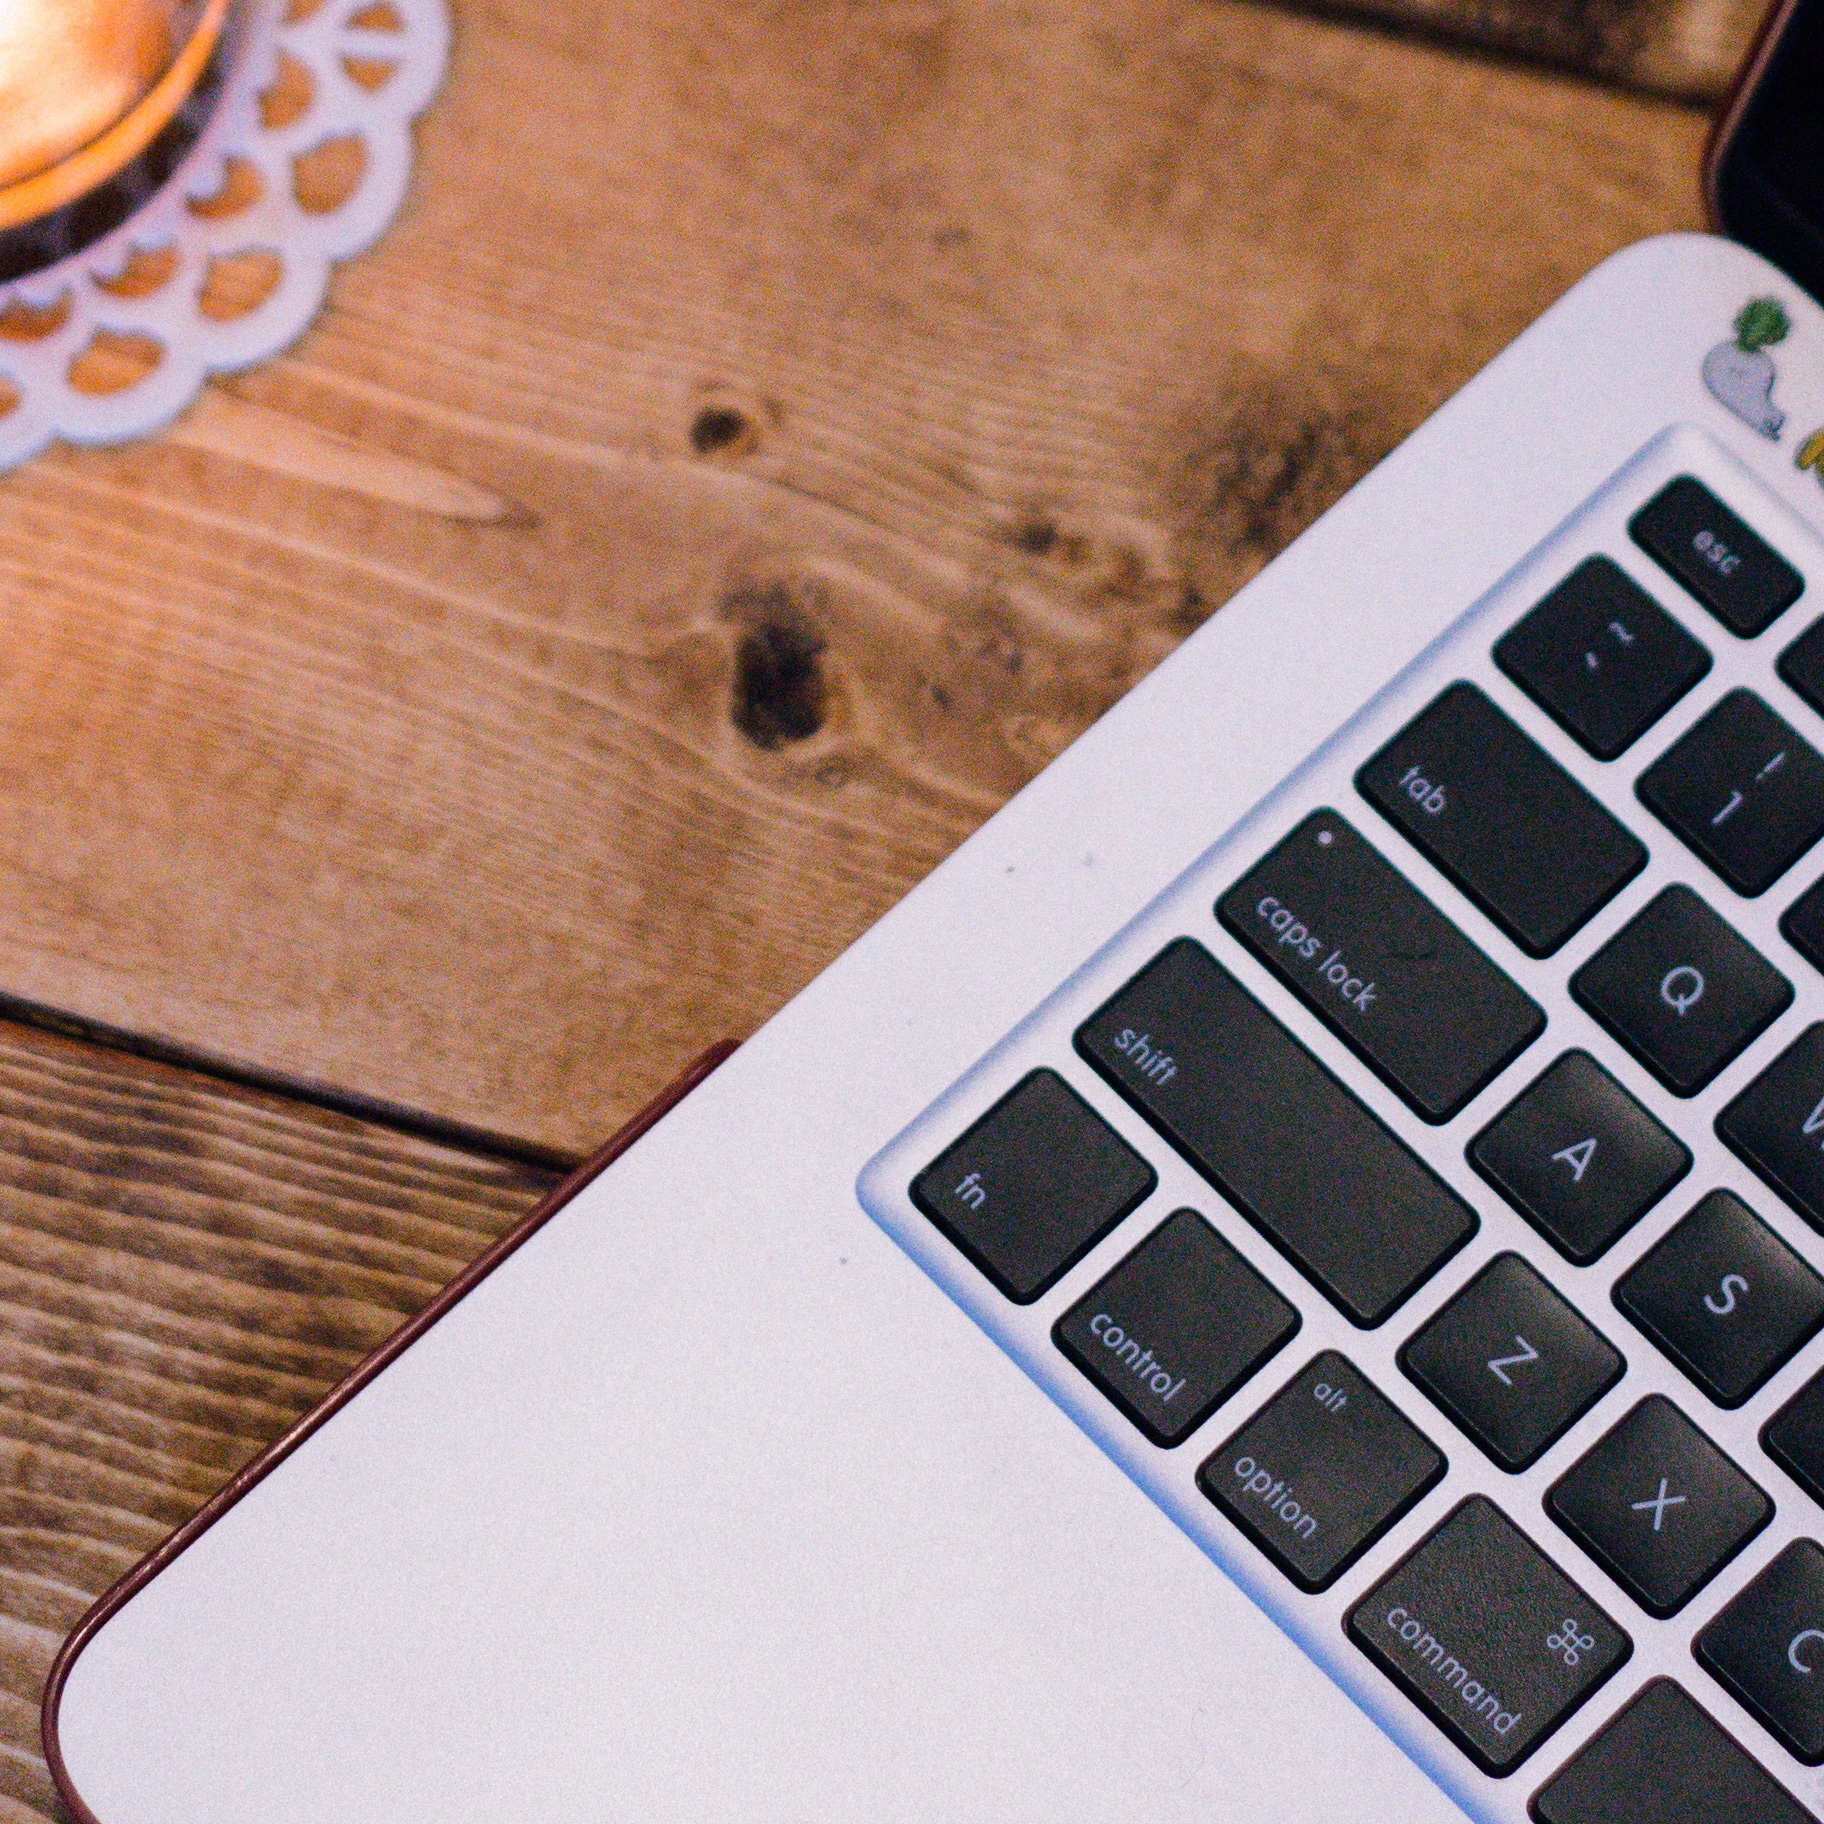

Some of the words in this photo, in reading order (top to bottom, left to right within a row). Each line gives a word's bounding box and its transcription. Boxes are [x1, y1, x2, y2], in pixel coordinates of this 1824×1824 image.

[1693, 529, 1742, 575] esc
[1399, 766, 1445, 814] tab
[1711, 790, 1743, 825] 1
[1256, 896, 1320, 960] caps
[1317, 949, 1375, 1012] lock
[1660, 965, 1705, 1015] Q
[1114, 1028, 1177, 1085] shift
[1551, 1137, 1597, 1182] A
[954, 1172, 986, 1209] fn
[1703, 1273, 1749, 1315] S
[1089, 1312, 1187, 1404] control
[1487, 1335, 1539, 1385] Z
[1313, 1382, 1347, 1412] alt
[1233, 1455, 1318, 1542] option
[1631, 1478, 1687, 1531] X
[1385, 1605, 1522, 1736] command
